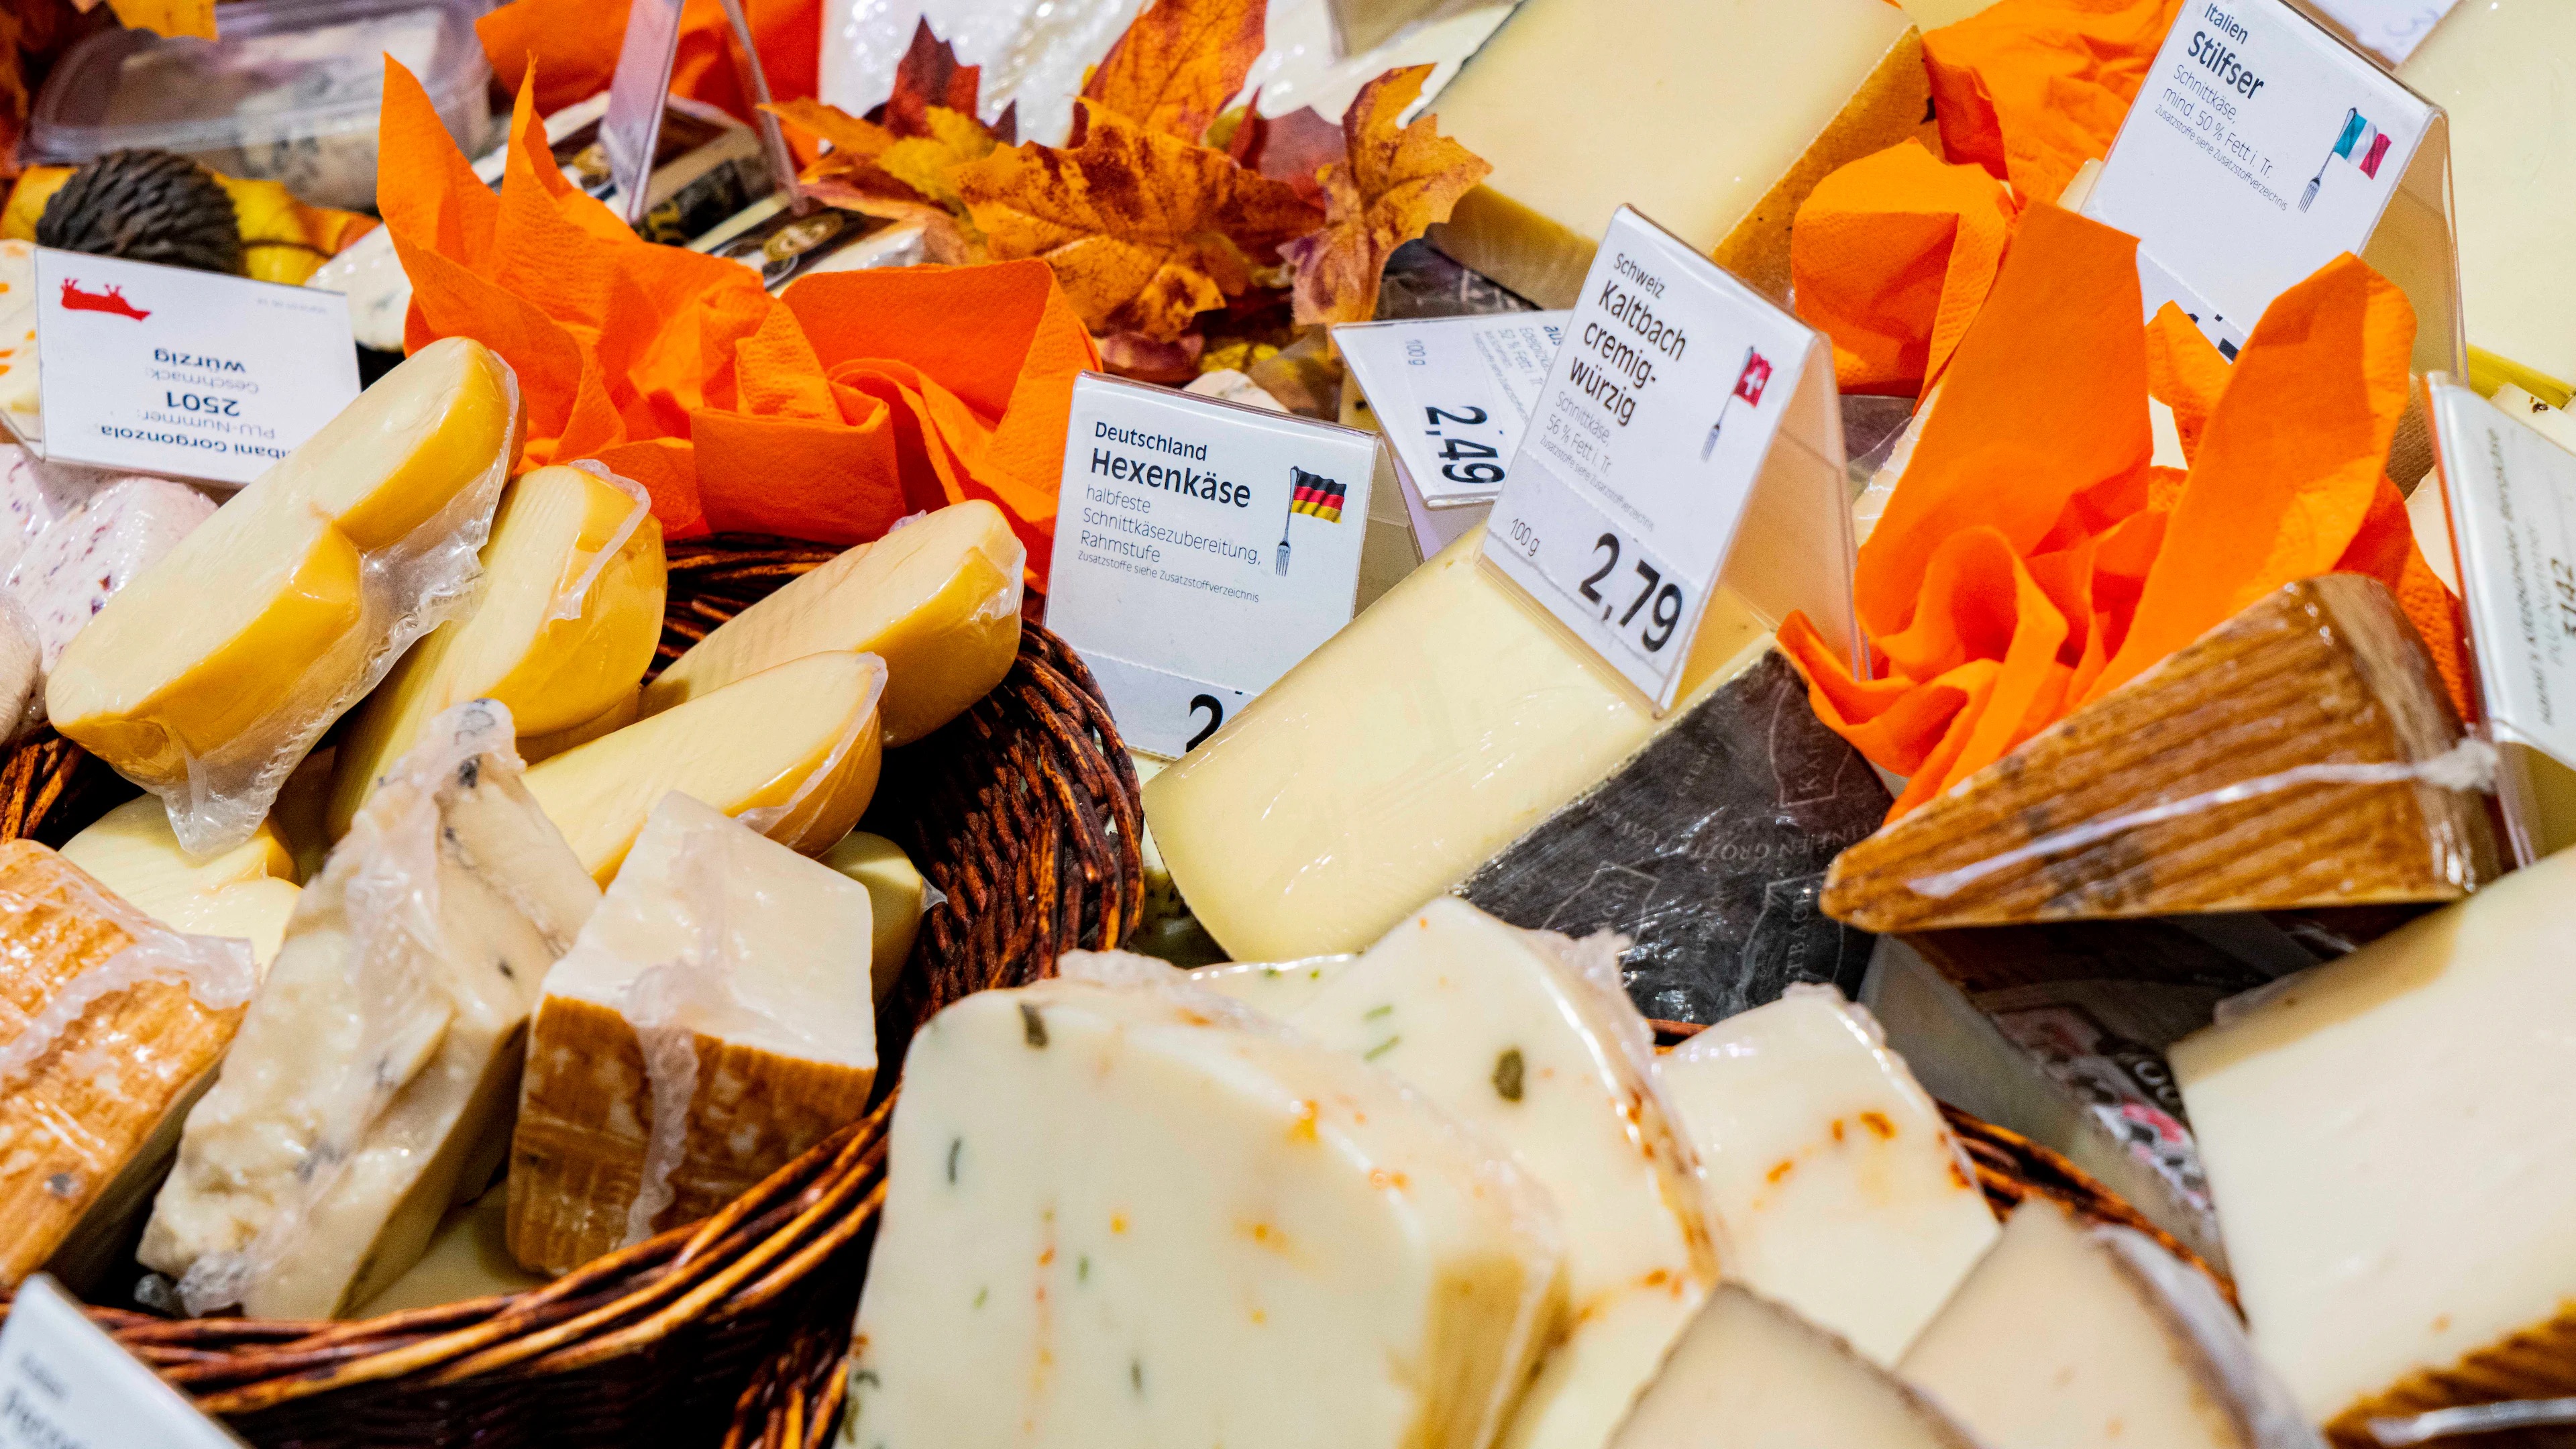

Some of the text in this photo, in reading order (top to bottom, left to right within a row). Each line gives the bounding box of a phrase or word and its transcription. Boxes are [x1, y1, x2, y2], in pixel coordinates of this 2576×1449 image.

[2204, 3, 2249, 44] Italien
[2188, 30, 2265, 100] Stilfser
[2173, 64, 2237, 125] Schnittkäse,
[2155, 104, 2288, 211] Zusatzstoffe siehe Zusatzstoffverzeichnis
[2162, 85, 2273, 179] mind. 50 % Fett i. Tr.
[1613, 252, 1666, 299] Schweiz
[1597, 280, 1687, 362] Kaltbach
[154, 347, 246, 373] würzig
[1583, 322, 1657, 389] cremig-
[166, 390, 240, 417] 2501
[1556, 391, 1610, 447] Schnittkäse,
[1569, 357, 1637, 427] würzig
[101, 425, 227, 454] Gorgonzola
[1095, 421, 1207, 461] Deutschland
[1425, 405, 1505, 484] 2,49
[1546, 414, 1562, 435] 56
[1571, 433, 1593, 461] Fett
[1086, 484, 1150, 513] halbfeste
[1090, 447, 1251, 508] Hexenkäse
[1081, 529, 1161, 563] Rahmstufe
[1082, 508, 1261, 566] Schnittkäsezubereitung,
[1509, 518, 1540, 557] 100 g
[1078, 550, 1260, 602] Zusatzstoffe siehe Zusatzstoffverzeichnis
[1578, 532, 1683, 653] 2,79
